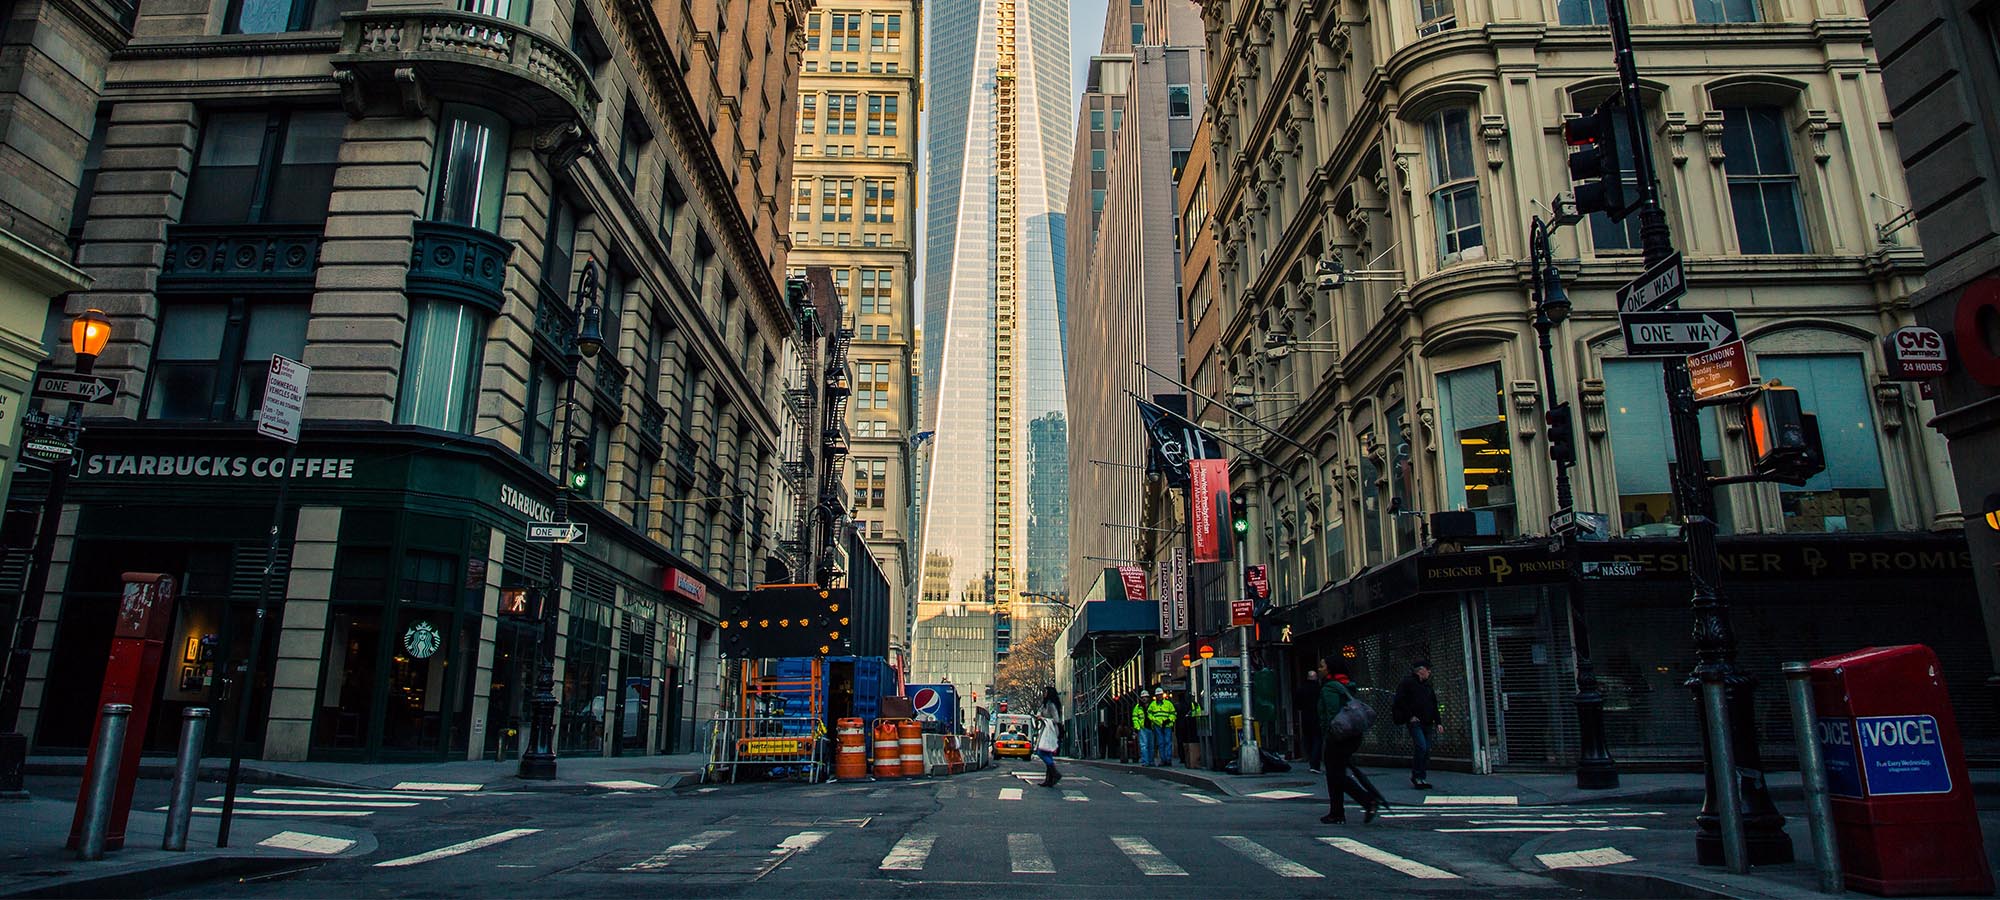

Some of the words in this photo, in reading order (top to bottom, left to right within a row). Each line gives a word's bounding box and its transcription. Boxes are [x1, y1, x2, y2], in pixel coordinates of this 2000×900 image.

[1627, 288, 1646, 312] ONE
[1653, 270, 1674, 296] WAY
[1640, 326, 1673, 342] ONE
[1686, 325, 1719, 341] WAY
[1897, 331, 1940, 349] CVS
[1690, 358, 1700, 368] NO
[1701, 347, 1735, 364] STANDING
[1901, 349, 1940, 358] pharmacy
[273, 357, 281, 373] 3
[1691, 366, 1711, 378] Monday
[1903, 363, 1913, 371] 24
[1915, 363, 1943, 371] HOURS
[46, 381, 69, 391] ONE
[79, 384, 104, 396] WAY
[271, 377, 299, 393] COMMERCIAL
[270, 386, 290, 399] VEHICLES
[290, 392, 302, 402] ONLY
[88, 454, 248, 477] STARBUCKS
[251, 457, 354, 479] COFFEE
[501, 484, 551, 522] STARBUCKS
[535, 528, 552, 537] ONE
[560, 529, 578, 537] WAY
[1428, 564, 1483, 578] DESIGNER
[1520, 559, 1568, 573] PROMISE
[1602, 565, 1636, 576] NASSAU
[1613, 553, 1784, 574] ESINER
[1849, 551, 1972, 569] PROMIS
[1818, 721, 1852, 746] OICE
[1865, 719, 1936, 747] VOICE
